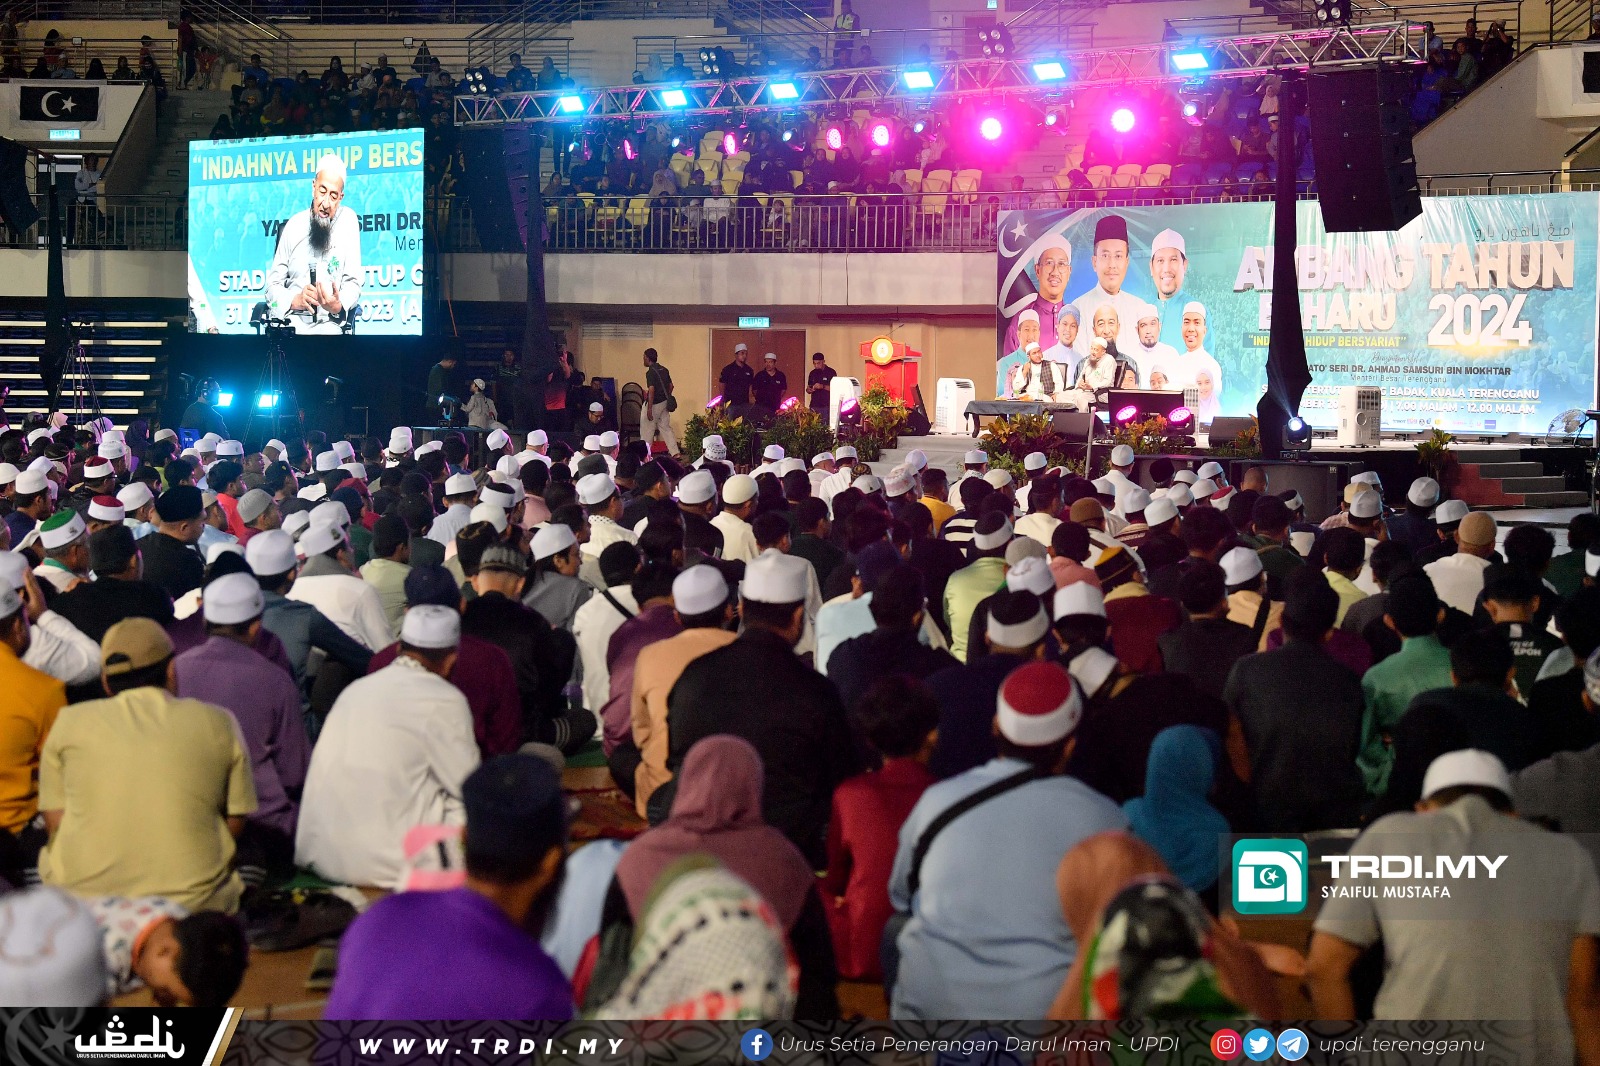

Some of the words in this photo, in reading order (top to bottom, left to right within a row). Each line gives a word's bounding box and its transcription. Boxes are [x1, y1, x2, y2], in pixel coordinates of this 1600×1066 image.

[1423, 240, 1575, 291] TAHUN
[219, 269, 267, 292] STAD
[1427, 293, 1533, 347] 2024
[1305, 335, 1335, 347] HIDUP
[1308, 364, 1327, 372] ATO'
[1329, 364, 1349, 372] SERI
[1351, 365, 1366, 373] DR.
[1368, 365, 1401, 374] AHMAD
[1402, 366, 1444, 375] SAMSURI
[1446, 367, 1462, 375] BIN
[1464, 367, 1512, 376] MOKHTAR
[1404, 375, 1447, 384] Terengganu
[1430, 388, 1466, 399] KUALA
[1468, 388, 1540, 400] TERENGGANU
[1419, 402, 1458, 413] MALAM
[1495, 405, 1536, 415] MALAM
